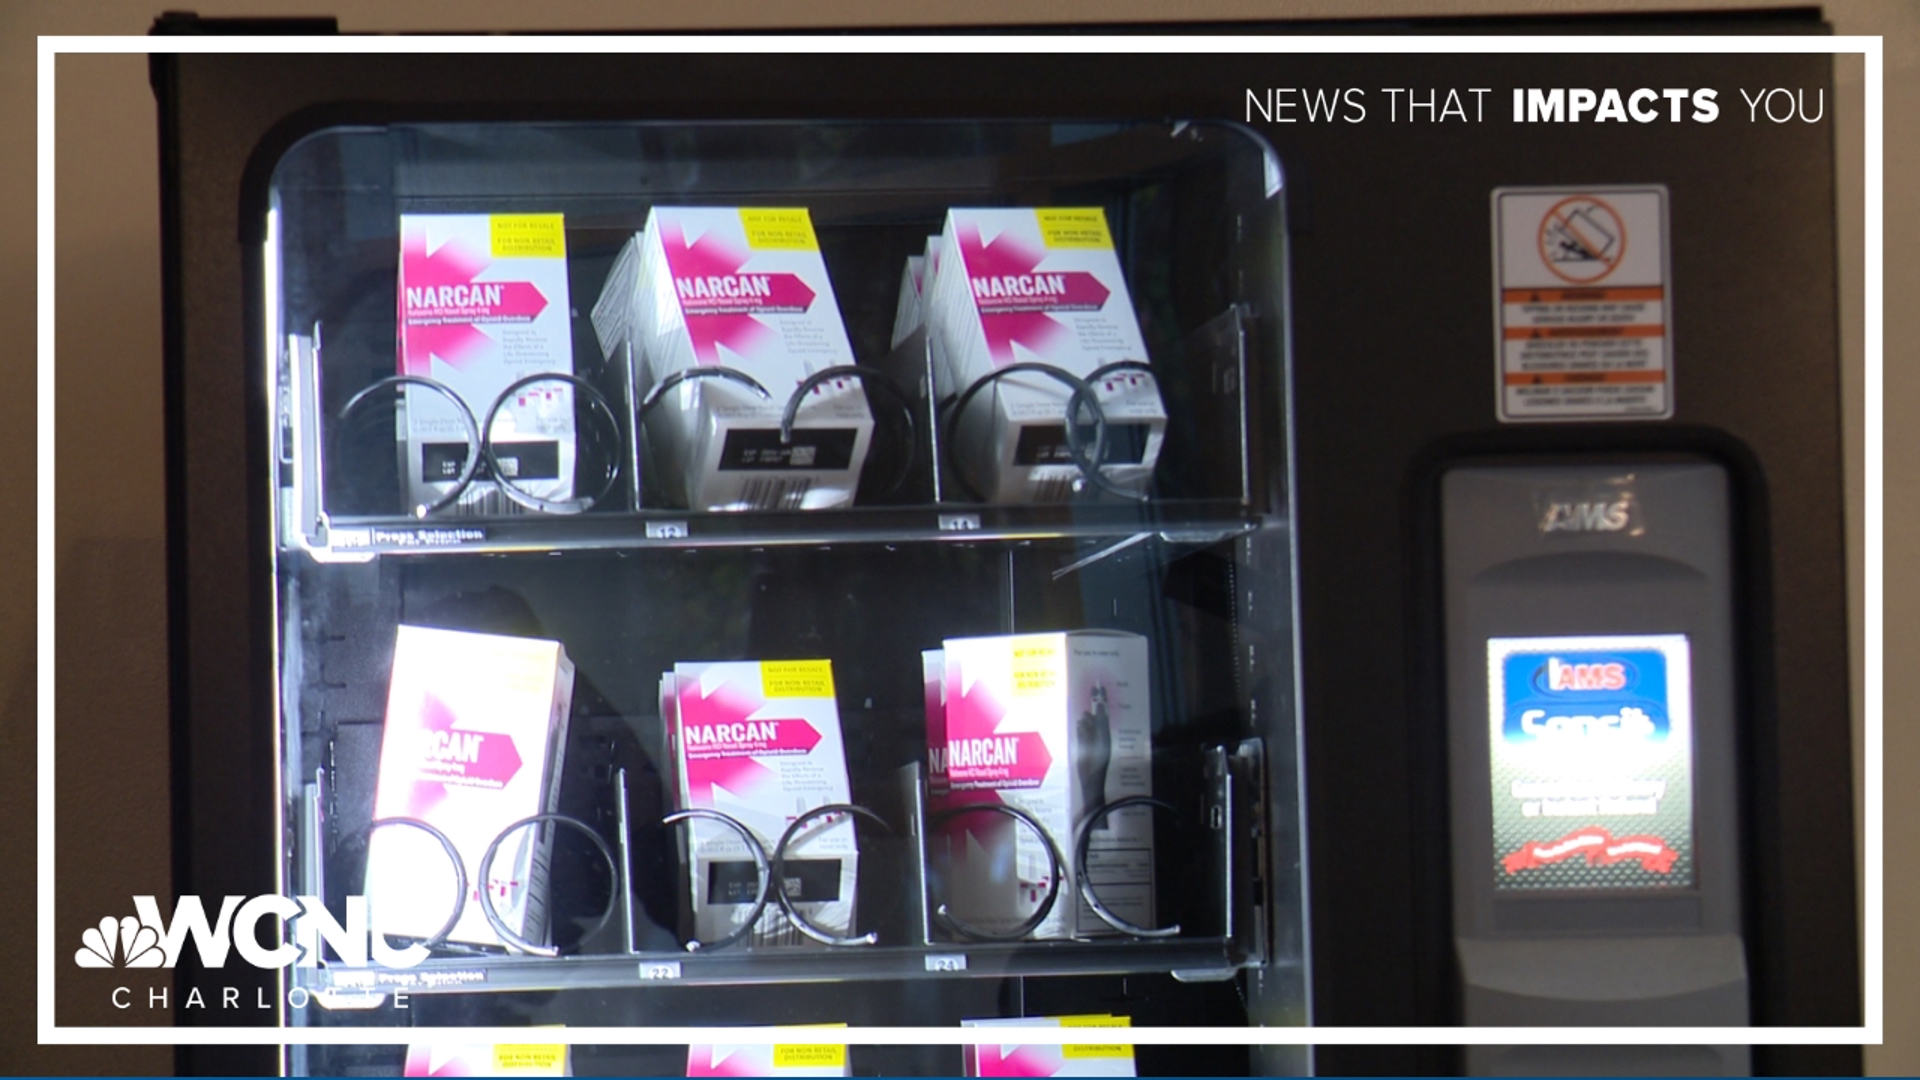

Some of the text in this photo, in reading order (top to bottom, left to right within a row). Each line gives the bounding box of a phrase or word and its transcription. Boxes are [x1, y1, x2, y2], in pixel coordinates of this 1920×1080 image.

[684, 722, 777, 745] NARCAN
[949, 738, 1018, 767] NARCAN
[652, 968, 669, 978] 22
